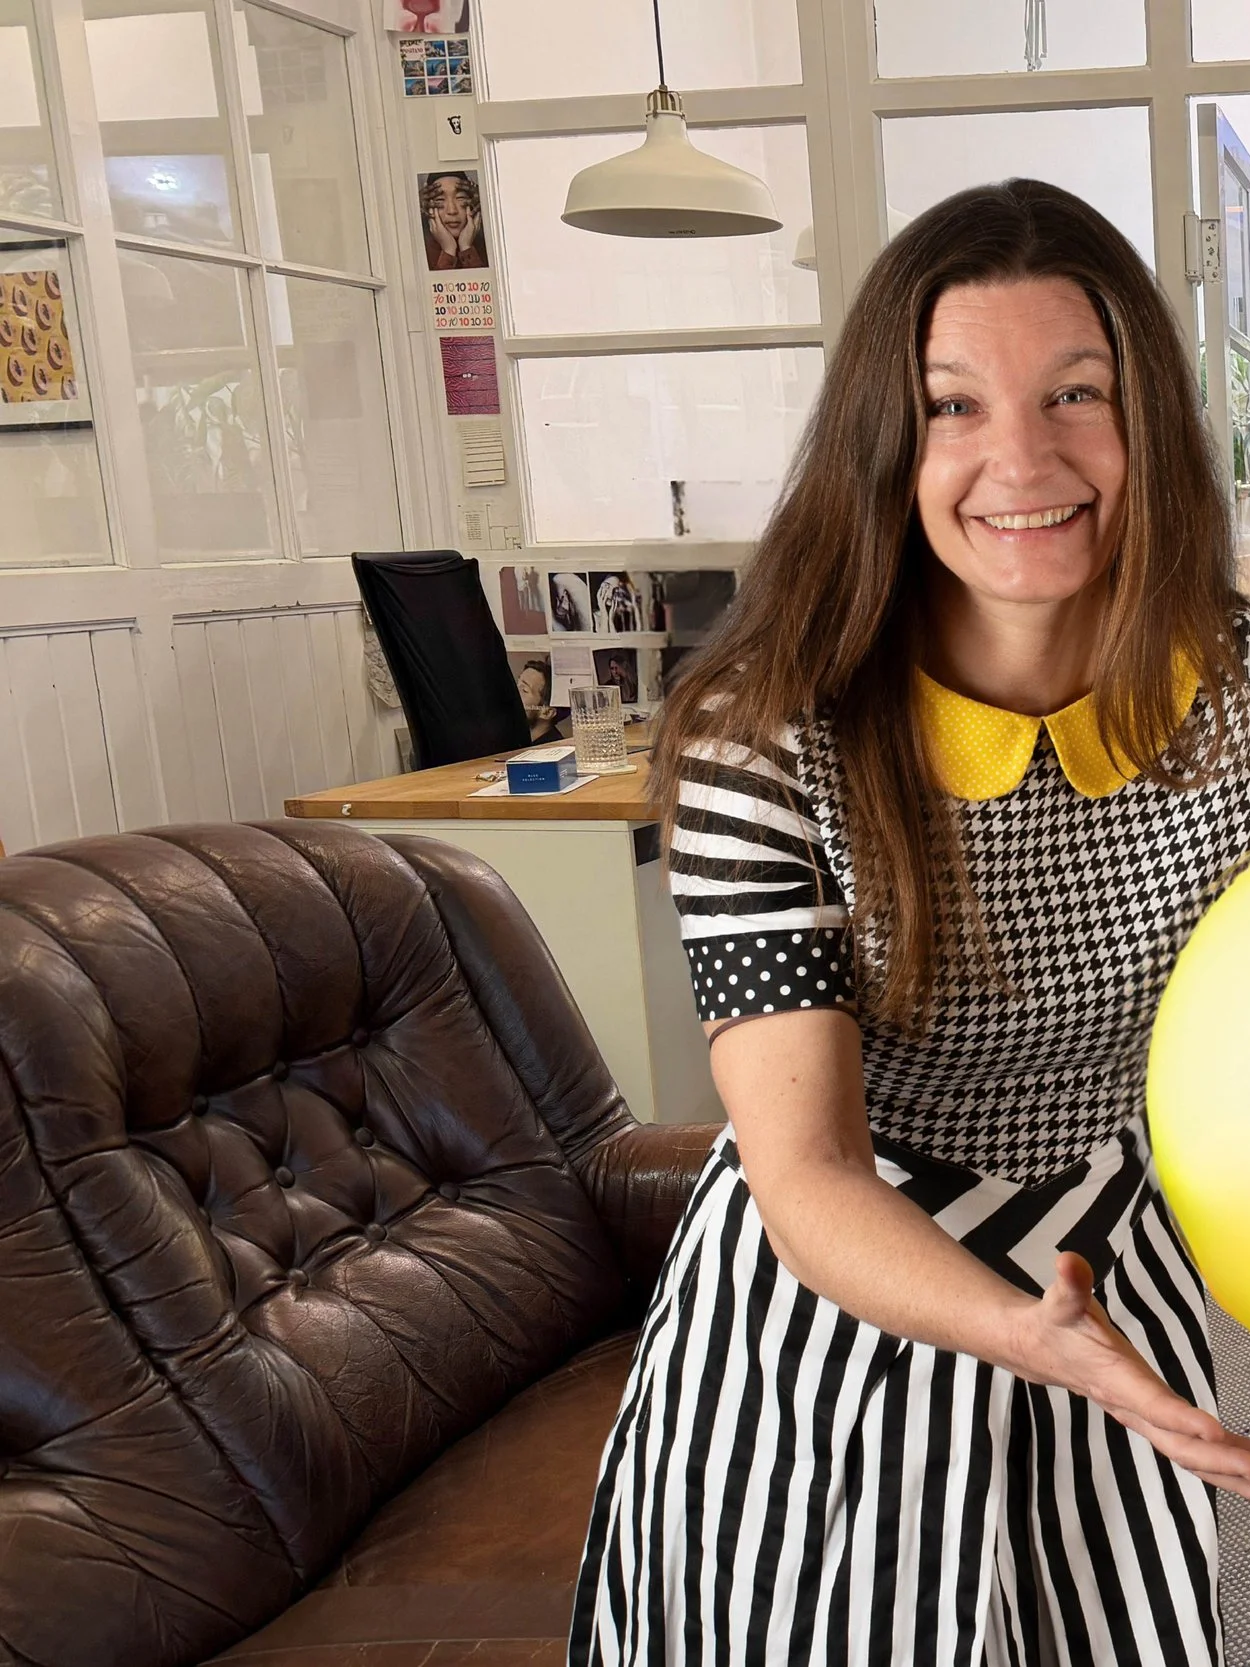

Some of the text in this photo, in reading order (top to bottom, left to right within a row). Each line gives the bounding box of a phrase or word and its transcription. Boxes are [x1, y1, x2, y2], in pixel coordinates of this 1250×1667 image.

[432, 282, 490, 292] 10 10 10 10 10
[433, 294, 444, 304] 10
[446, 294, 456, 304] 10
[458, 294, 466, 303] 10
[481, 293, 491, 303] 10
[435, 305, 492, 315] 10 10 10 10 10
[436, 317, 493, 327] 10 10 10 10 10
